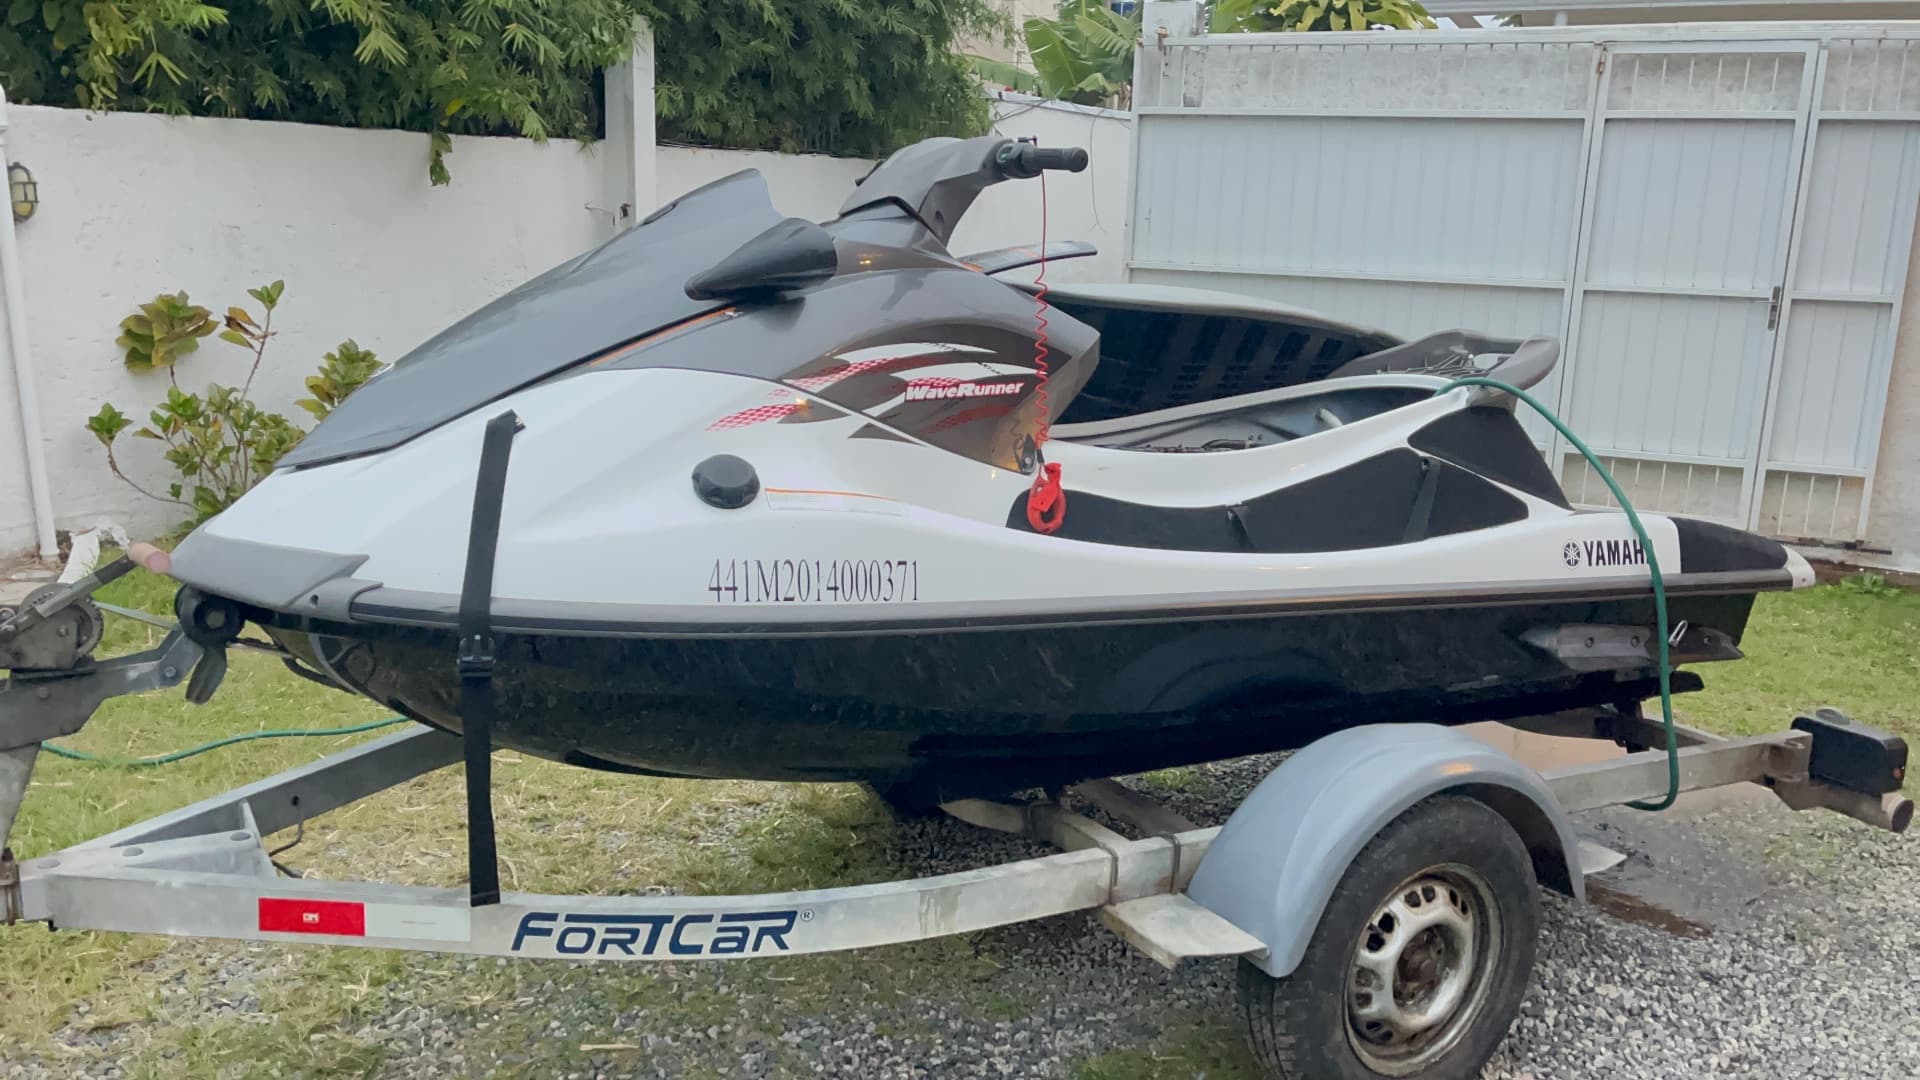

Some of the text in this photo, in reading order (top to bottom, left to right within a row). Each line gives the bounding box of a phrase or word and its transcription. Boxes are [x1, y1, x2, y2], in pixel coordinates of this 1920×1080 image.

[905, 382, 1024, 401] WaveRunner
[1583, 539, 1650, 567] YAMAH
[708, 559, 918, 602] 441M2014000371
